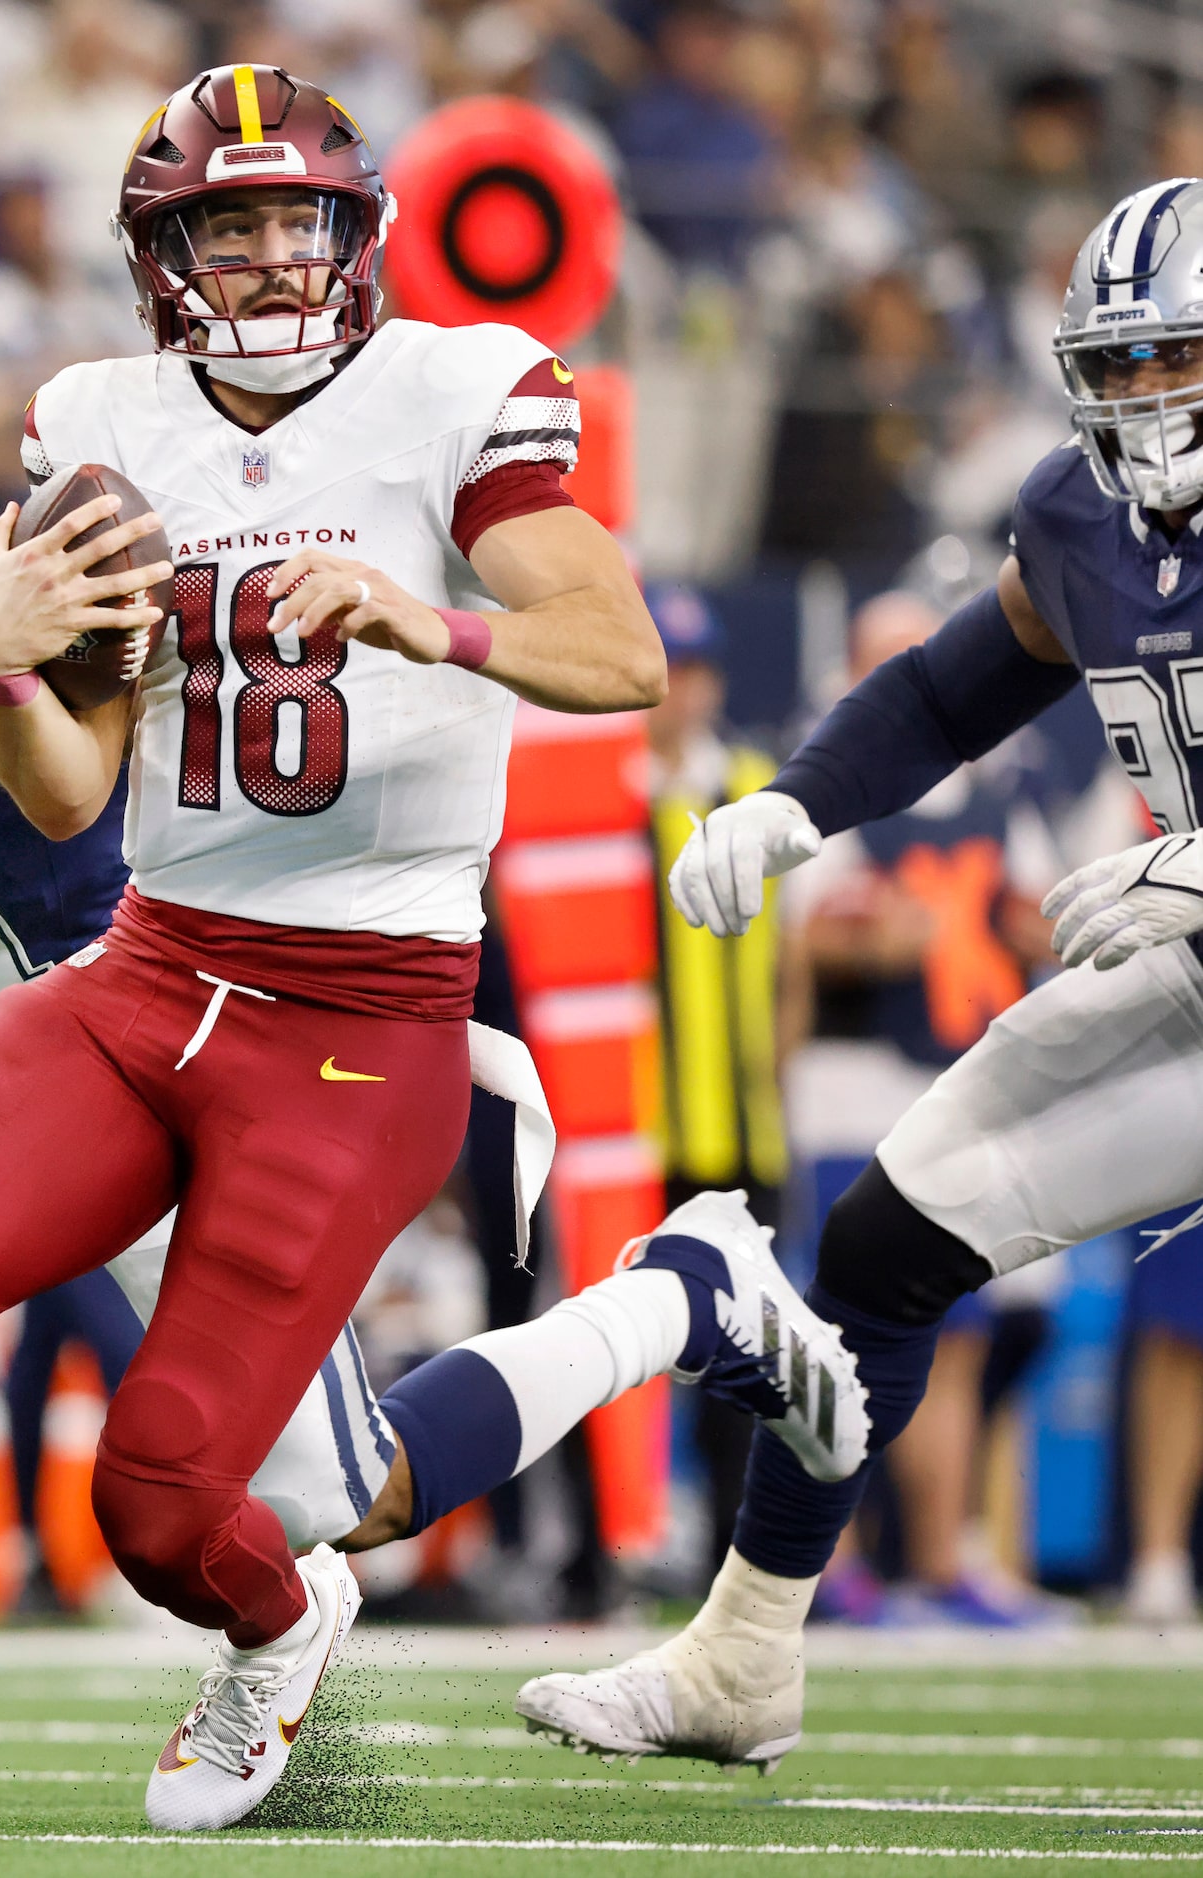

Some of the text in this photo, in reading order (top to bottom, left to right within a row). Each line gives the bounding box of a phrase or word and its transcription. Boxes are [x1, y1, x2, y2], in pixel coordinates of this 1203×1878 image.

[1097, 309, 1145, 323] COWBOYS
[246, 467, 265, 482] NFL
[170, 528, 357, 558] ASHINGTON
[170, 560, 348, 816] 18
